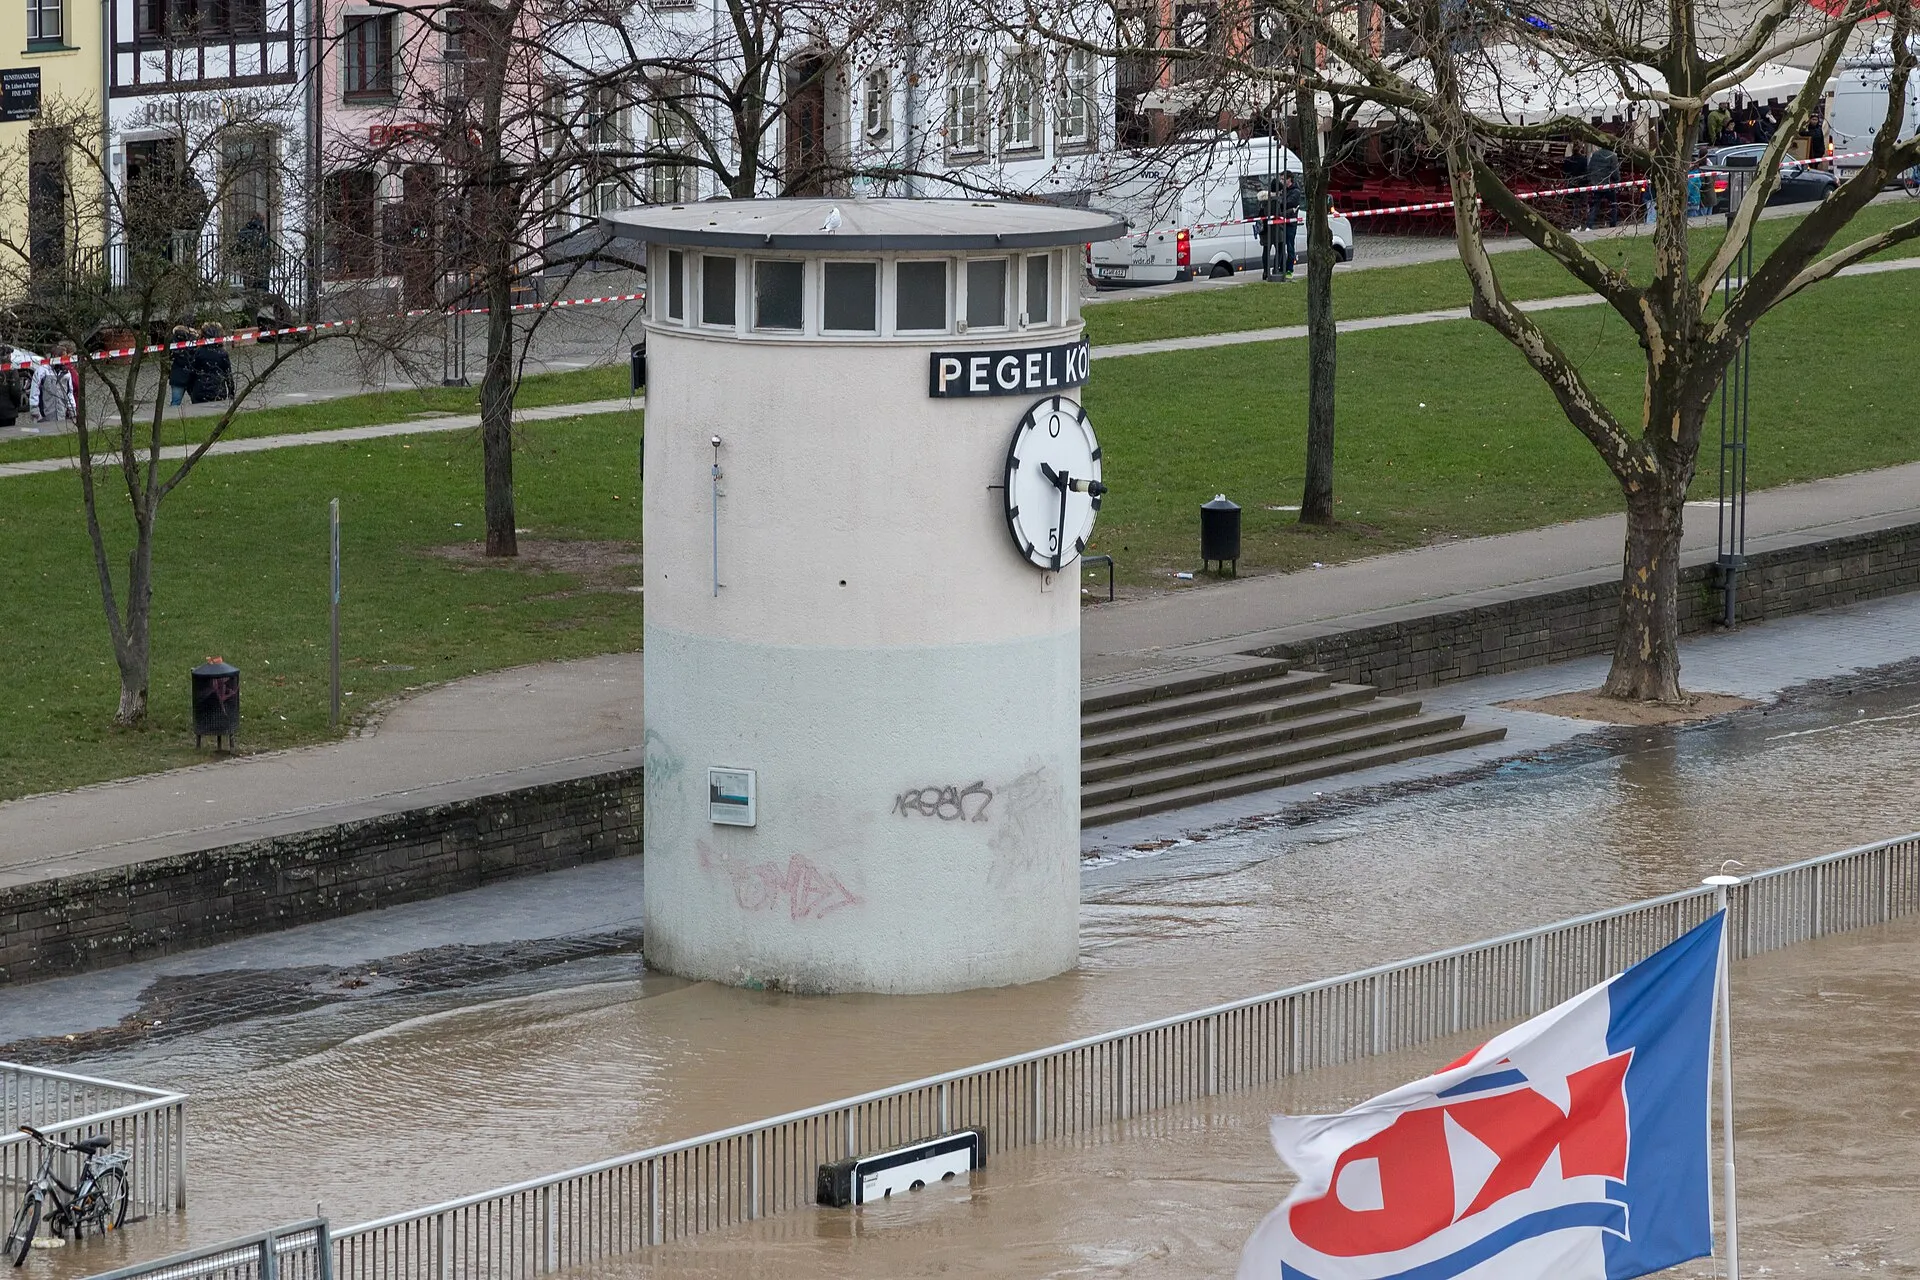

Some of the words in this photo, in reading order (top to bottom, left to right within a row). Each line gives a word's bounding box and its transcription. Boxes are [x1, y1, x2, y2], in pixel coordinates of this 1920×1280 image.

[1140, 171, 1160, 179] WDR
[1133, 257, 1155, 265] wdr.de
[938, 352, 1058, 392] PEGEL
[1049, 414, 1060, 438] 0
[1049, 528, 1058, 552] 5
